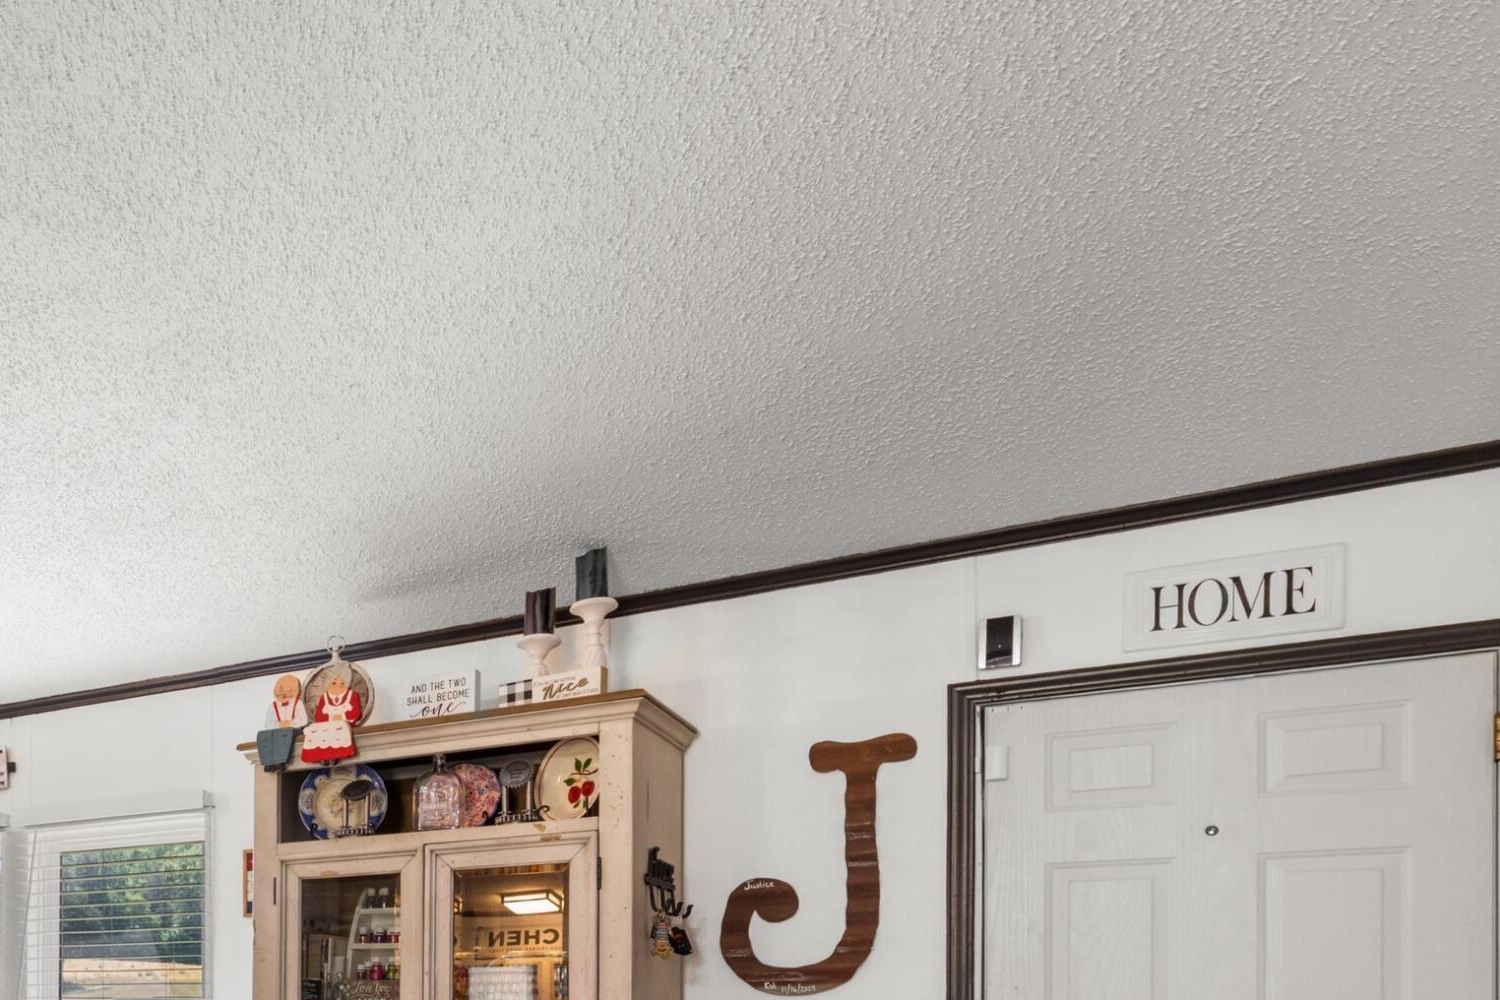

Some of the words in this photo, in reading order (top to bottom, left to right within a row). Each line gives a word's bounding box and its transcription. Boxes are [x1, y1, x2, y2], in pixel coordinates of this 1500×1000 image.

[1149, 566, 1317, 632] HOME
[410, 683, 427, 694] AND
[430, 681, 445, 691] THE
[448, 677, 467, 688] TWO
[541, 677, 589, 701] Nice
[406, 694, 433, 706] SHALL
[436, 688, 469, 702] BECOME
[409, 700, 467, 718] one
[719, 732, 918, 997] J
[743, 879, 775, 891] Justice
